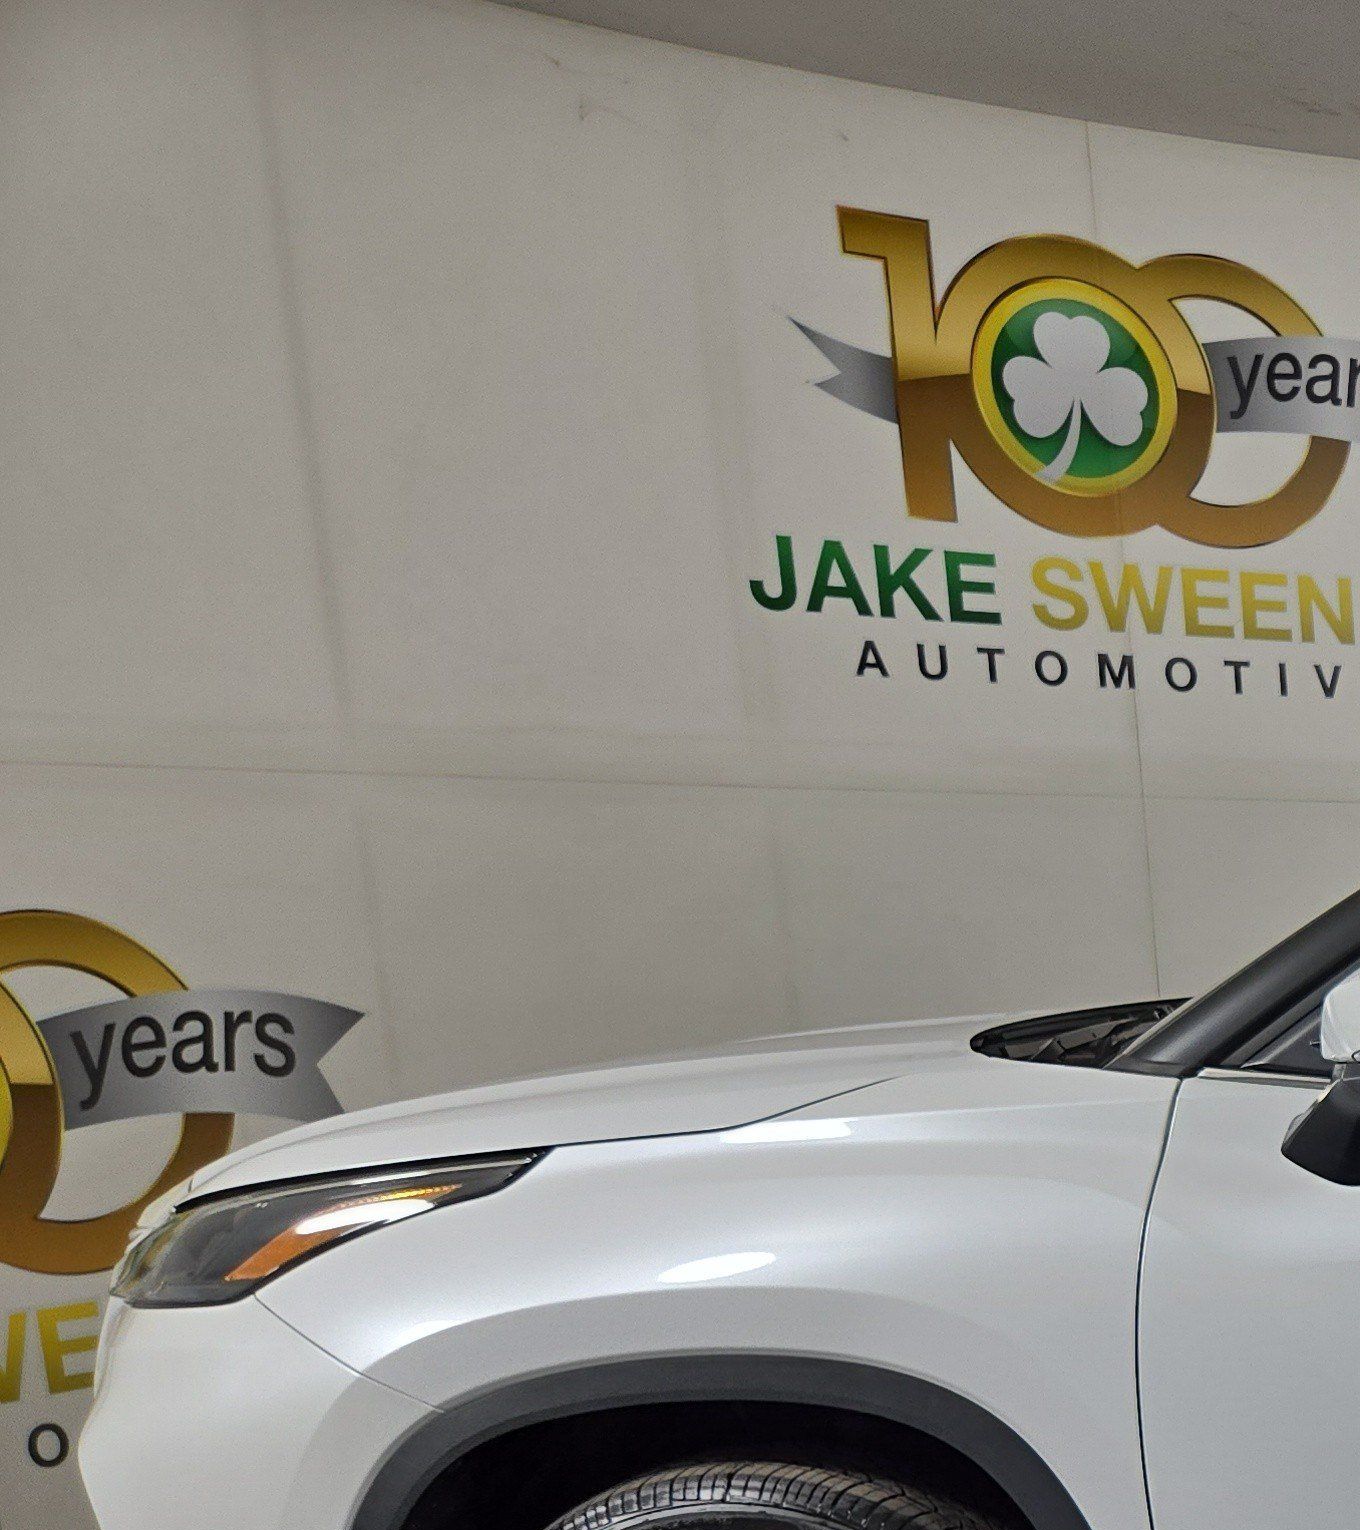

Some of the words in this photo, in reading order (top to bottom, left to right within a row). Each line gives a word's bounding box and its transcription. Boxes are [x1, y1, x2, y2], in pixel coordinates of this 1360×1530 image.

[836, 204, 1351, 549] 100
[749, 534, 1003, 626] JAKE
[70, 1006, 298, 1111] years
